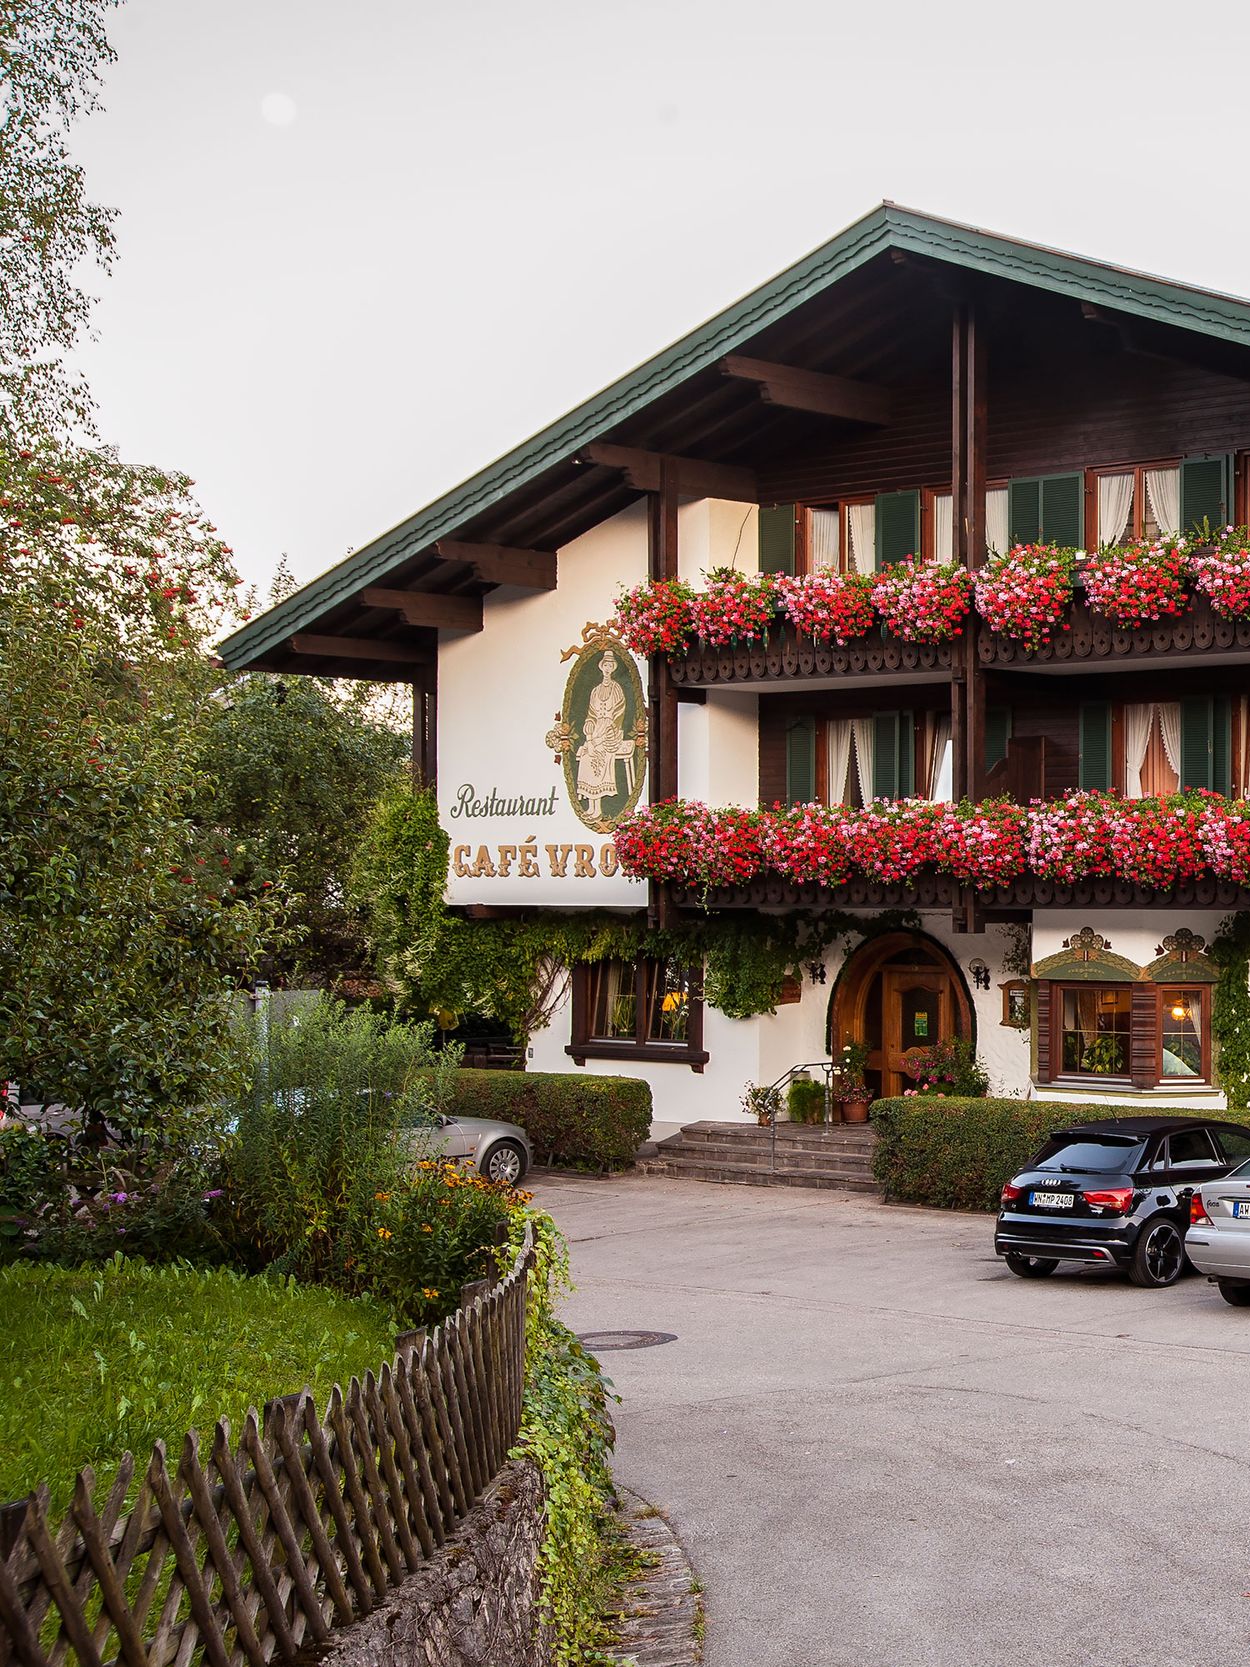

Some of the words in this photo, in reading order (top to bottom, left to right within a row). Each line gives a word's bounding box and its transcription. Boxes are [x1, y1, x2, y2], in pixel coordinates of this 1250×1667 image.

[450, 783, 559, 819] Restaurant
[453, 835, 540, 878] CAFÉ
[545, 843, 634, 878] VRO
[1239, 1204, 1250, 1216] AW
